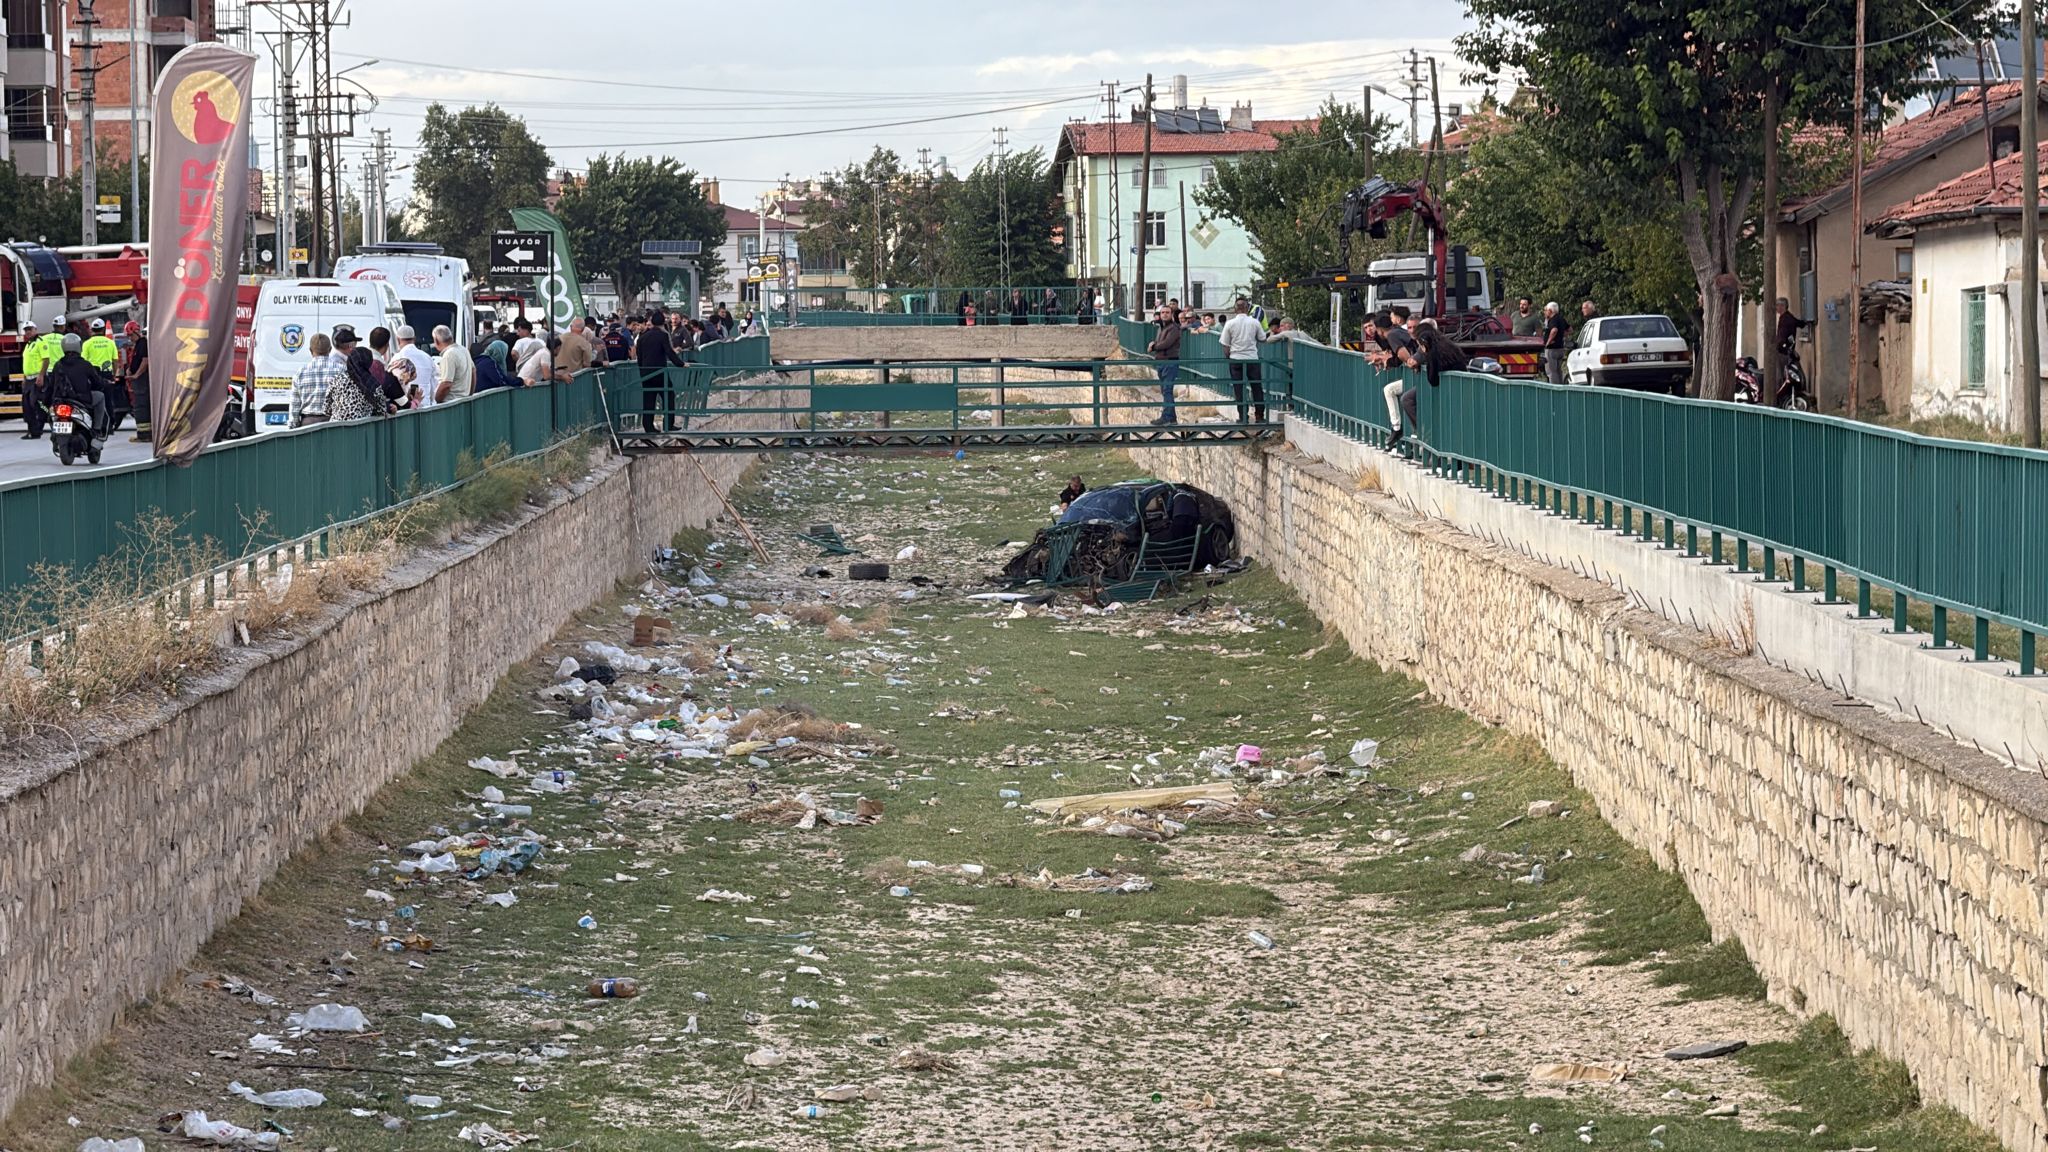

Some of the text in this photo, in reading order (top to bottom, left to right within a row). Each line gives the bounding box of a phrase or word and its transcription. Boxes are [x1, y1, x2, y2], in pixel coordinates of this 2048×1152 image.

[174, 159, 217, 320] DÖNER
[497, 237, 541, 246] KUAFÖR
[212, 246, 225, 284] Lezzet
[491, 265, 548, 273] AHMET BELEN
[273, 295, 292, 304] OLAY
[294, 294, 310, 304] YERİ
[311, 294, 348, 304] İNCELEME
